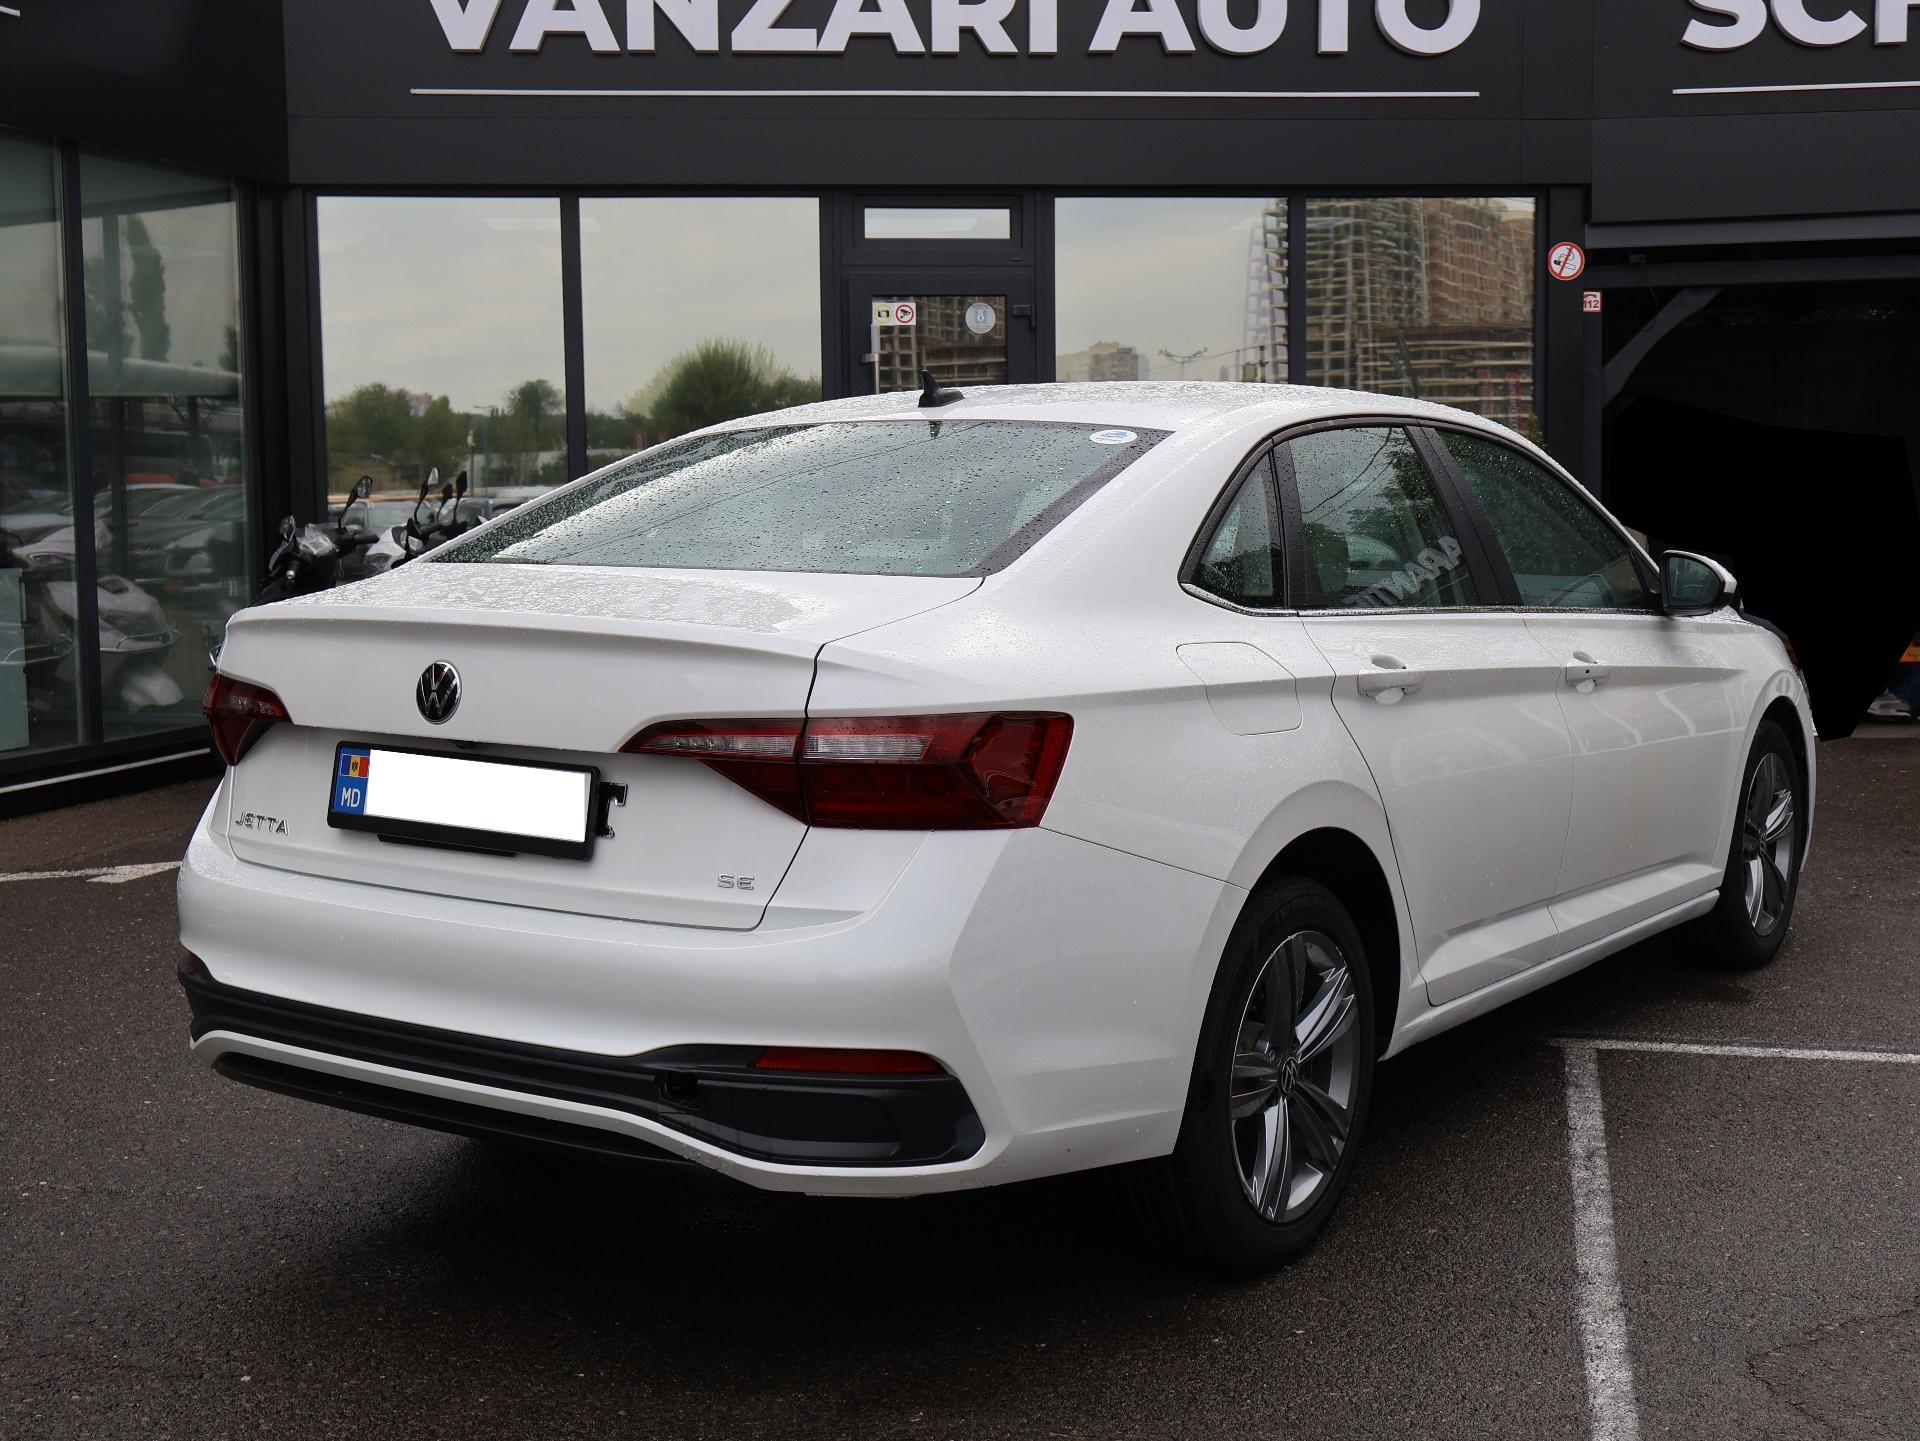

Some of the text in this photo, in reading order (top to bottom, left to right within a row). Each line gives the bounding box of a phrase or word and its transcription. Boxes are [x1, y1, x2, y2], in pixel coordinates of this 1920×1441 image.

[1680, 0, 1920, 51] SC
[340, 786, 361, 808] MD
[235, 811, 288, 836] JETTA
[717, 873, 754, 890] SE
